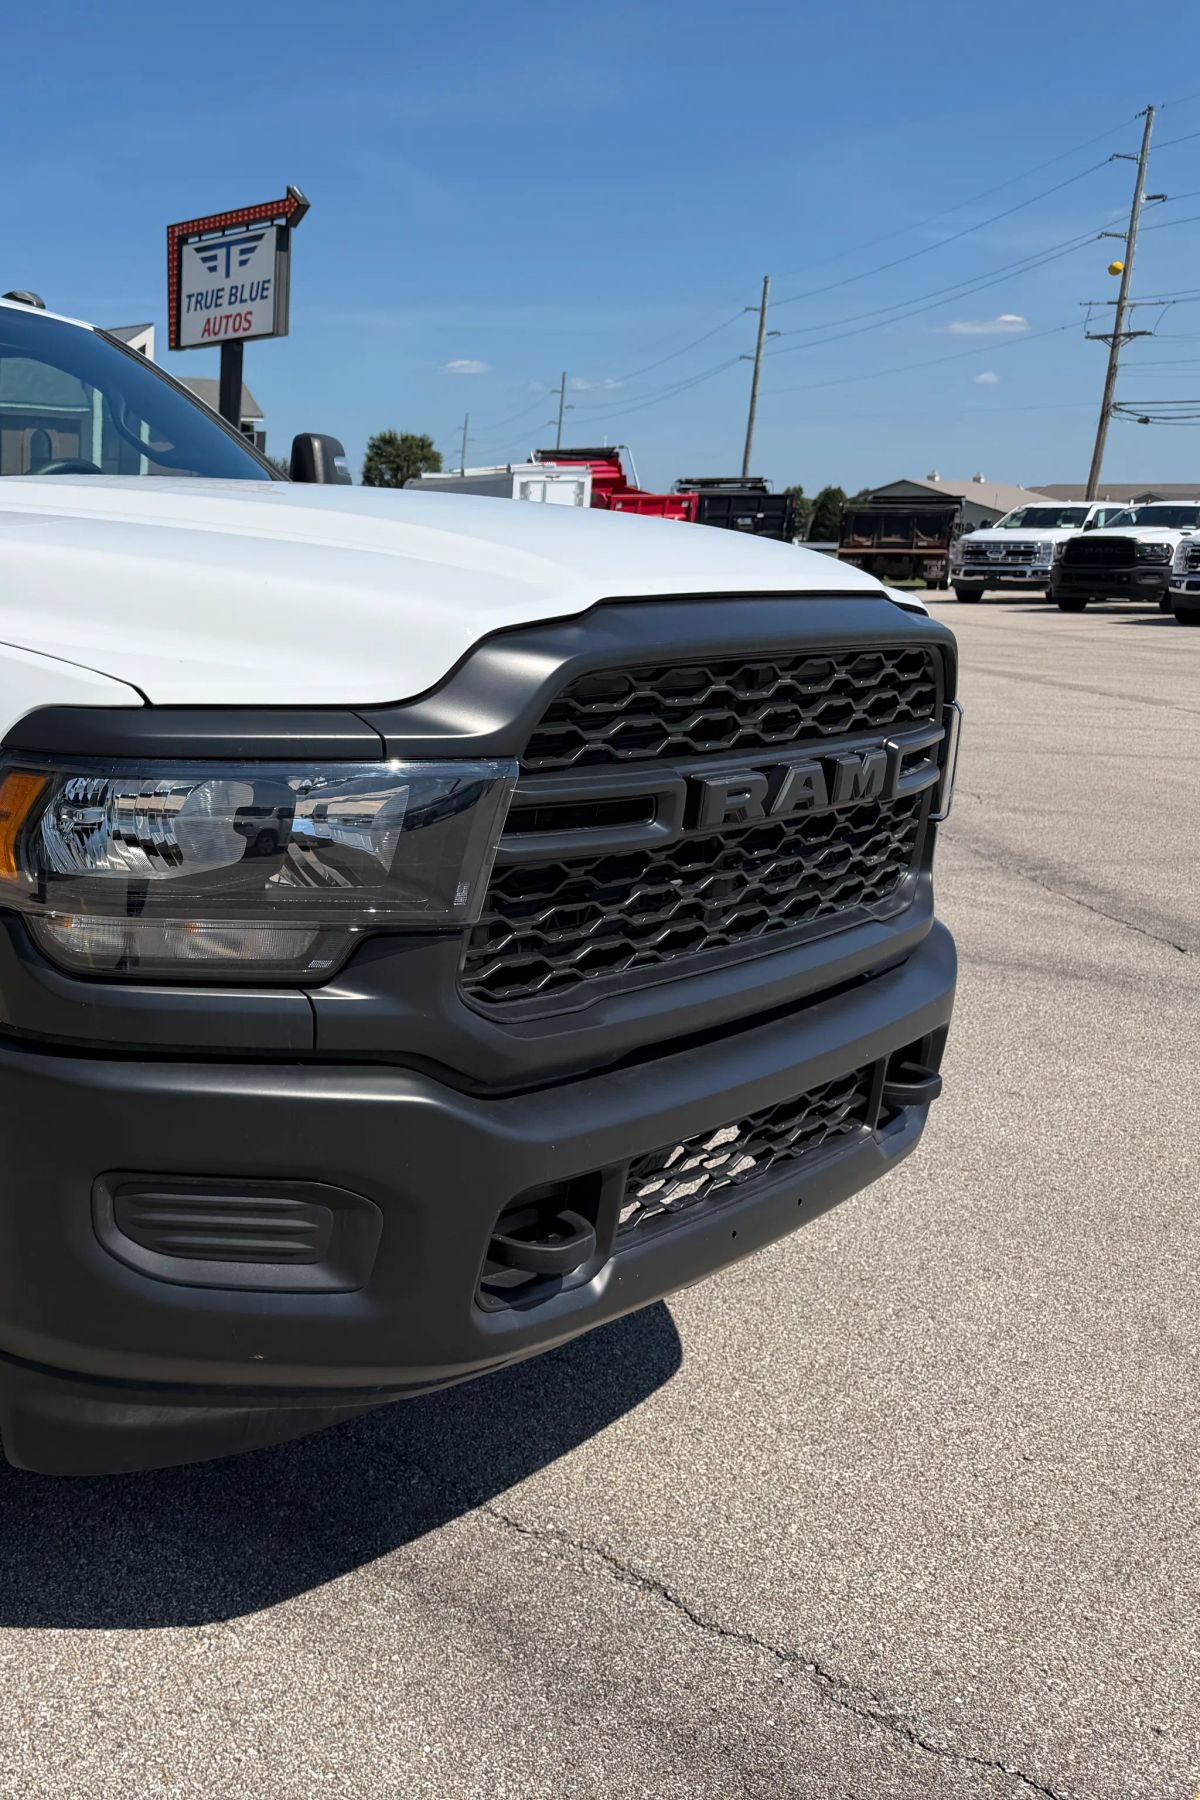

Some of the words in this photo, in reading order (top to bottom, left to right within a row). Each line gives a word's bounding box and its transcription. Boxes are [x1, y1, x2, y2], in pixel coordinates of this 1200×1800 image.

[186, 287, 225, 313] TRUE
[228, 279, 271, 306] BLUE
[201, 311, 253, 338] AUTOS
[691, 749, 888, 831] RAM
